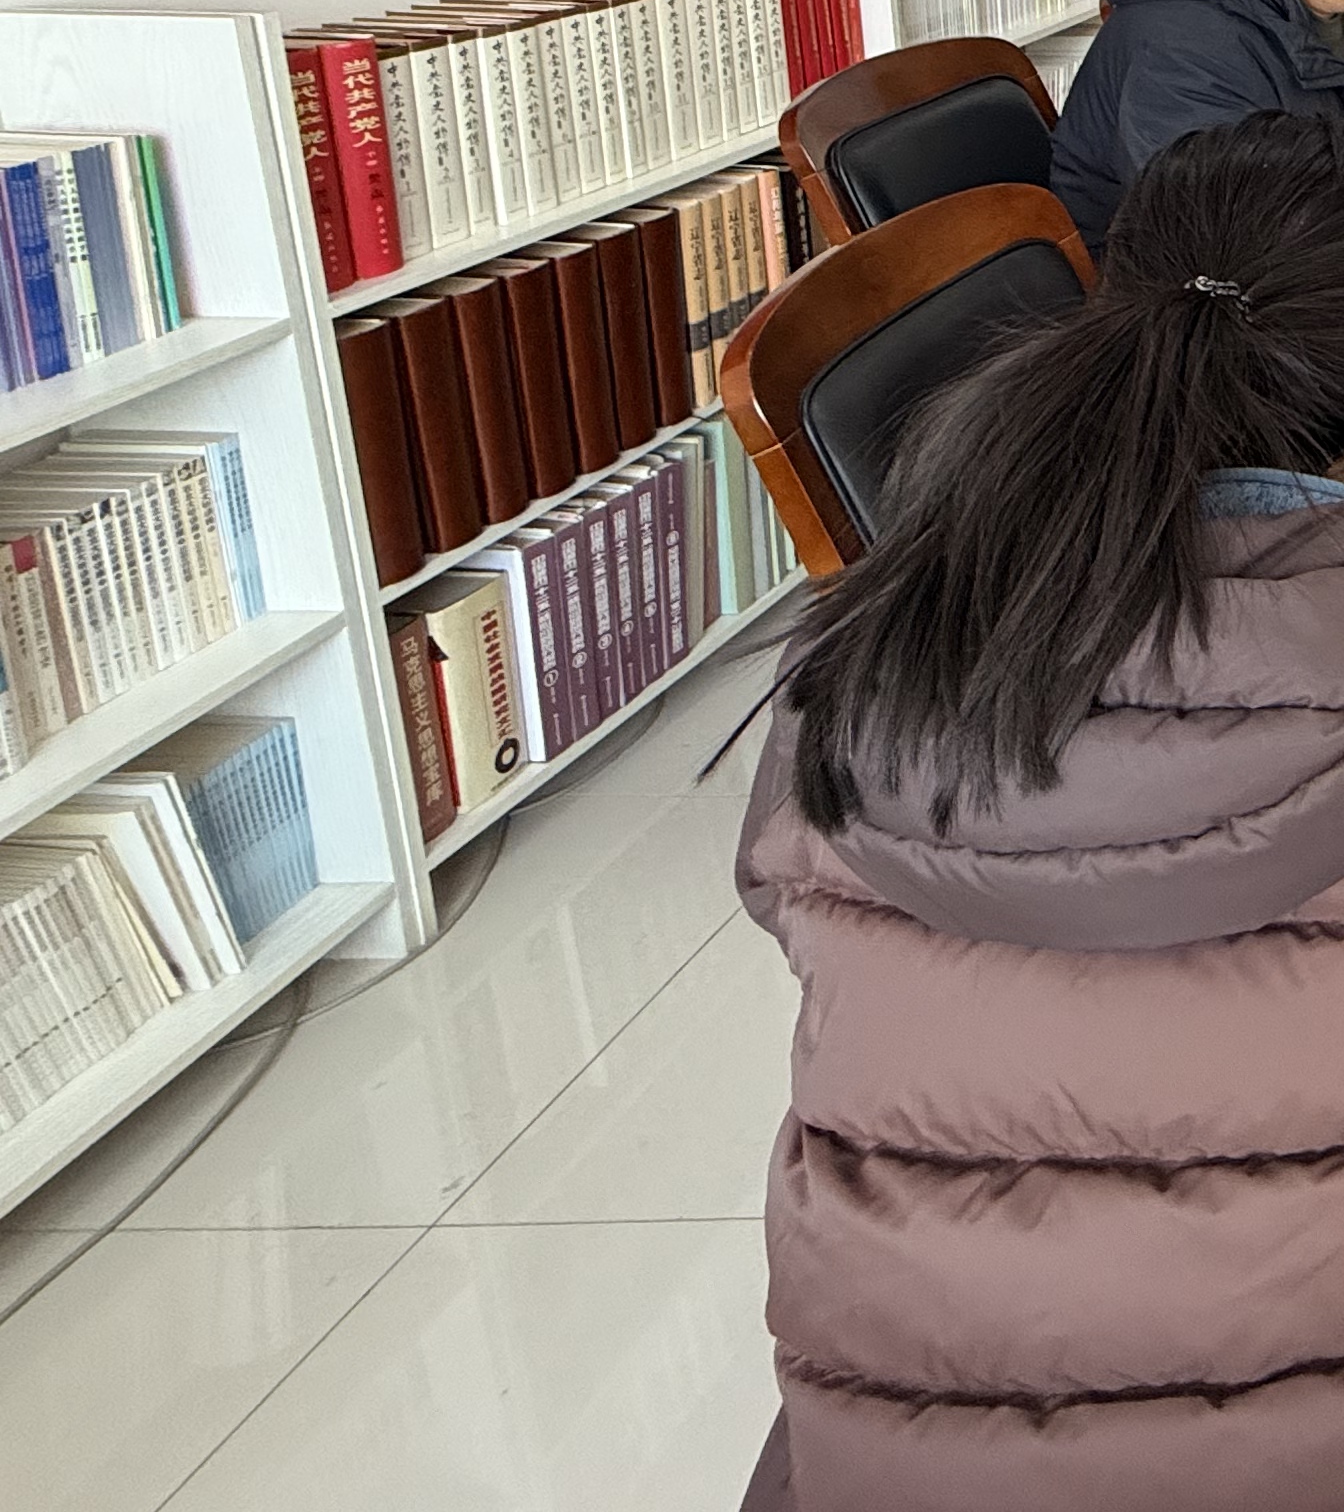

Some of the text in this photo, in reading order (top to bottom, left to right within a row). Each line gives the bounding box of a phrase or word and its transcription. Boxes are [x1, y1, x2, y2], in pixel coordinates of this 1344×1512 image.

[342, 58, 384, 148] 当代共产党人
